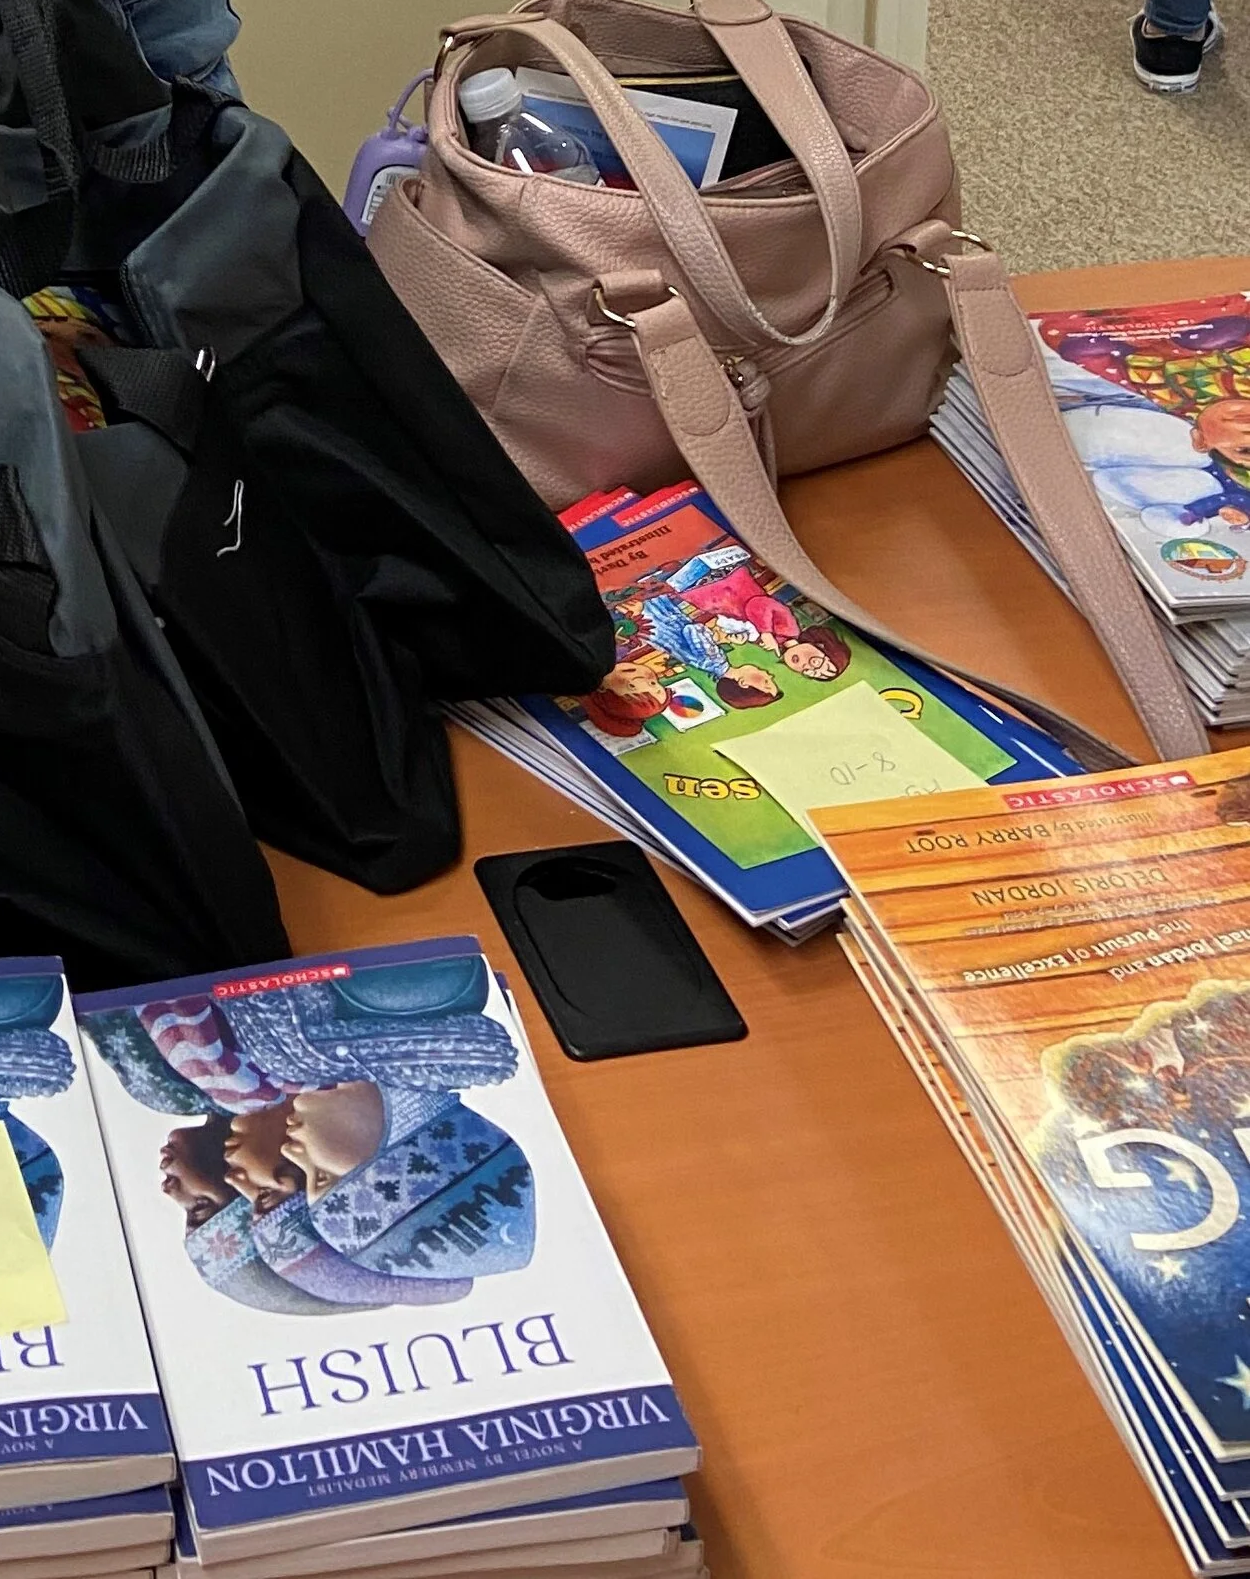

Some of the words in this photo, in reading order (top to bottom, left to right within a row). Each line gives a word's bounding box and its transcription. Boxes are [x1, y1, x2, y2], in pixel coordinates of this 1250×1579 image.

[600, 524, 673, 562] Illustrated
[595, 557, 628, 576] Davi
[628, 550, 649, 563] By
[1008, 776, 1169, 809] SCHOLASTIC
[905, 832, 970, 854] ROOT
[975, 823, 1051, 846] BARRY
[971, 879, 1068, 907] JORDAN
[1073, 867, 1169, 894] DELORIS
[1158, 919, 1193, 934] the
[1091, 927, 1162, 958] Pursuit
[1146, 939, 1216, 968] Jordan
[961, 952, 1071, 983] Excellence
[1065, 947, 1091, 967] of
[217, 969, 331, 997] SCHOLASTIC
[1108, 961, 1149, 982] and
[247, 1312, 576, 1417] BLUISH
[458, 1393, 671, 1447] VIRGINIA
[45, 1438, 56, 1449] A
[509, 1444, 565, 1464] NOVEL
[572, 1439, 584, 1452] A
[206, 1429, 451, 1497] HAMILTON
[398, 1457, 478, 1484] NEWBERY
[483, 1453, 505, 1468] BY
[307, 1472, 393, 1497] MEDALIST
